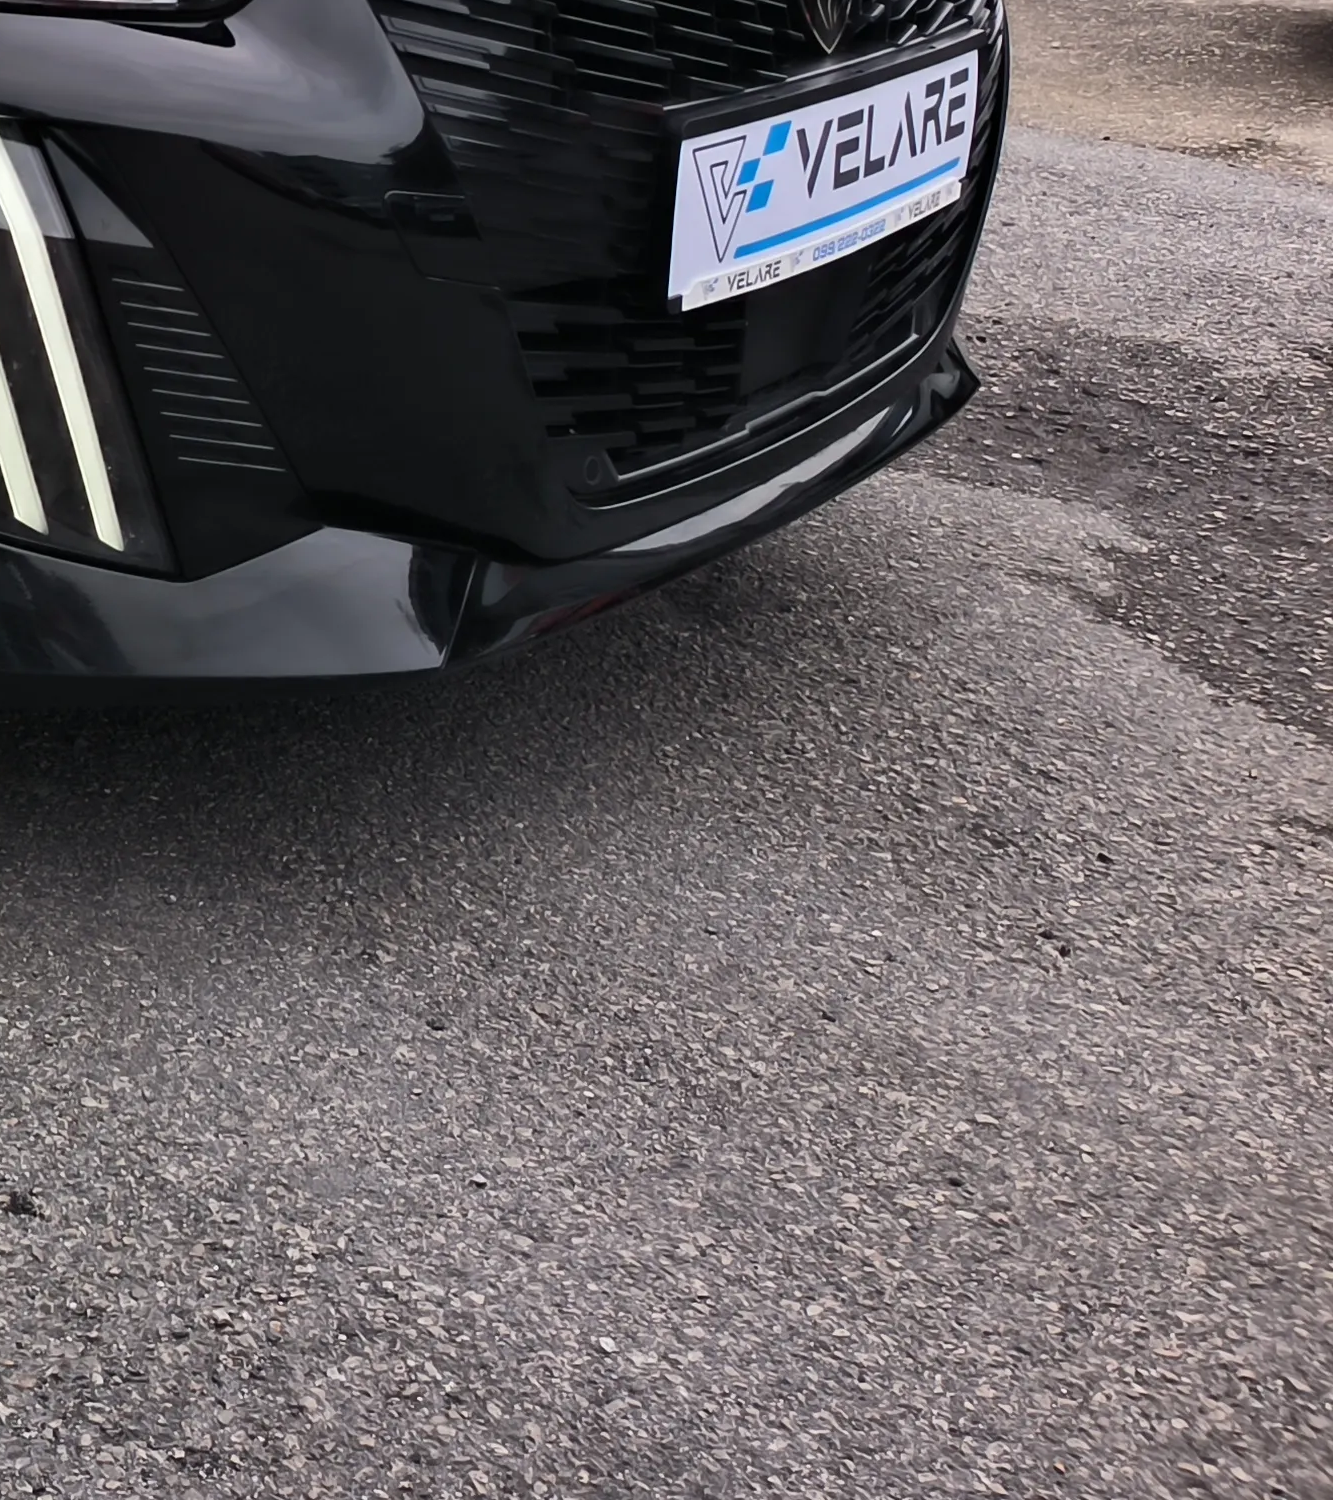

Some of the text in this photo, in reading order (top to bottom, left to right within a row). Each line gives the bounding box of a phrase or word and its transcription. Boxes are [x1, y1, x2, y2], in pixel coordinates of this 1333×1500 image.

[796, 67, 969, 199] VELARE
[727, 260, 782, 292] VELARE
[908, 190, 942, 220] VELARE
